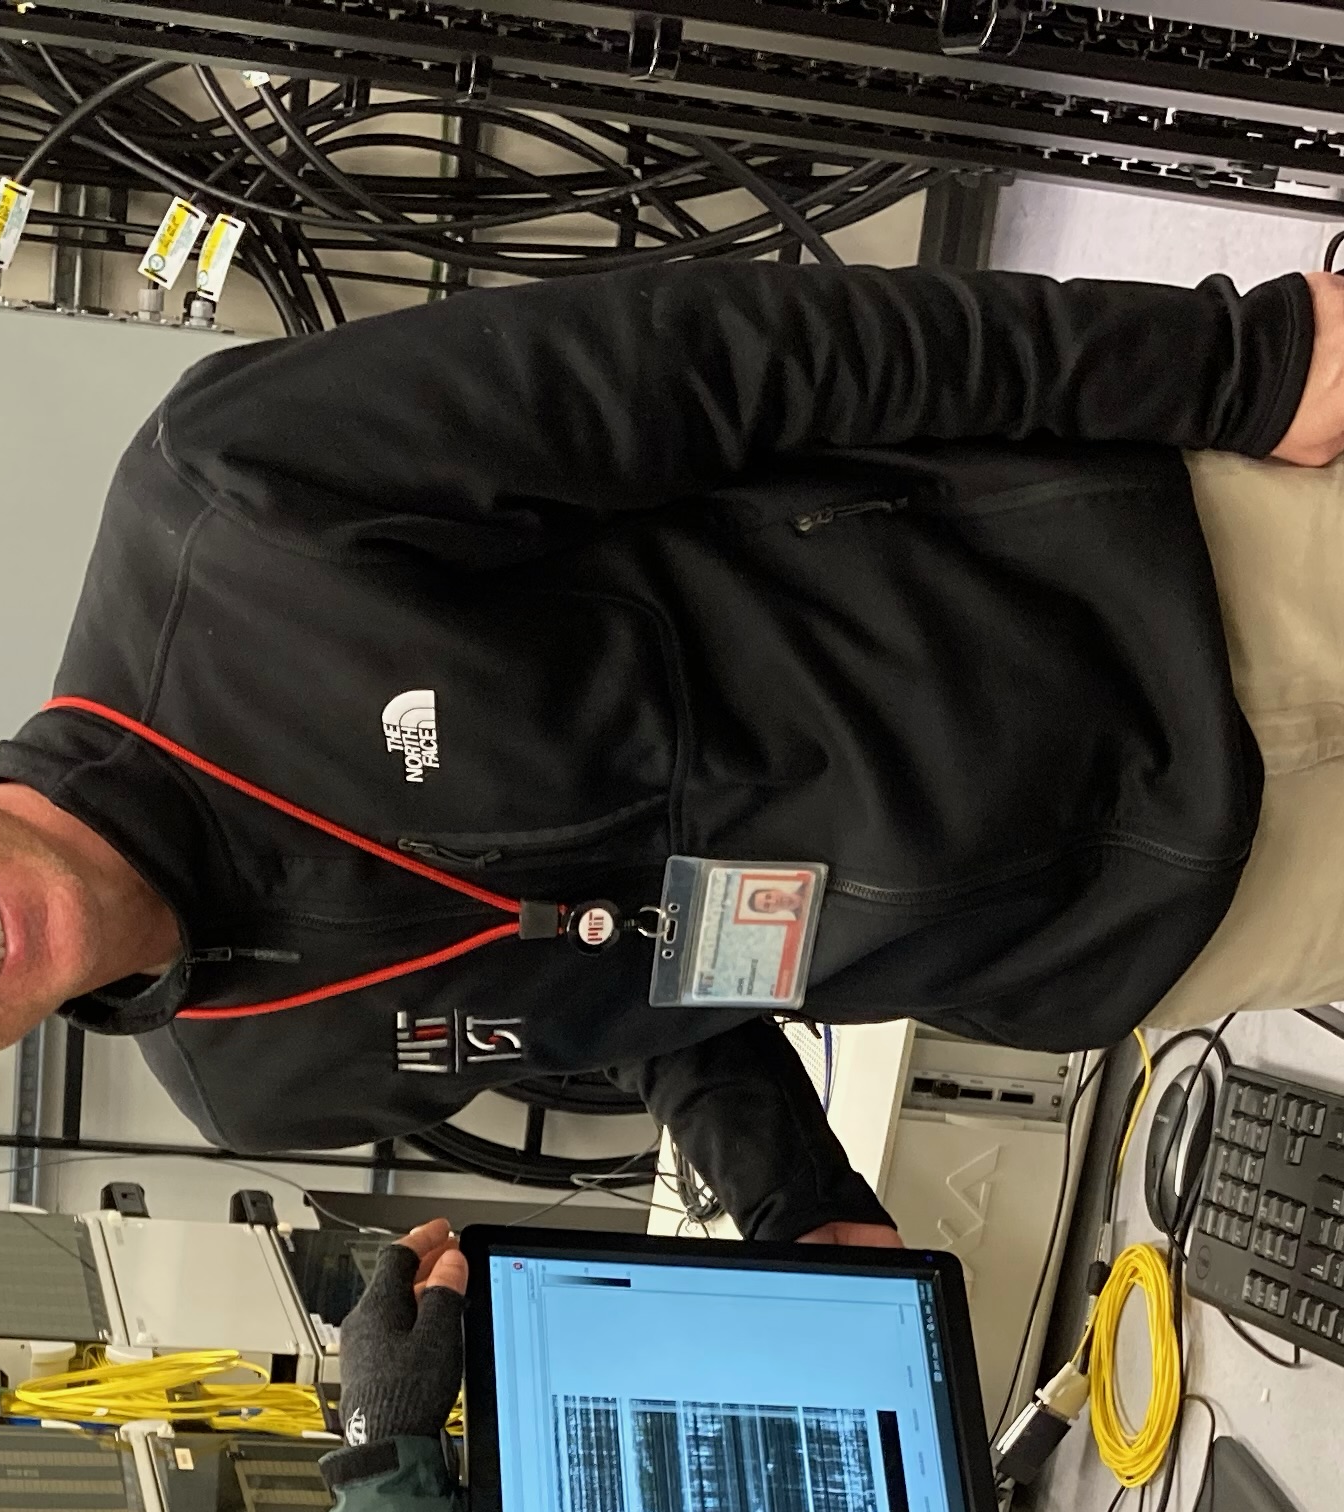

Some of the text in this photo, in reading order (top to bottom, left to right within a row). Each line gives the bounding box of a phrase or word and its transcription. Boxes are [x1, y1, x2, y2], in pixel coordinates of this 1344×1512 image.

[383, 723, 404, 752] THE
[401, 726, 424, 783] NORTH
[419, 728, 440, 768] FACE
[587, 912, 604, 942] MIT
[397, 1010, 449, 1073] MIT
[466, 1015, 522, 1062] IST
